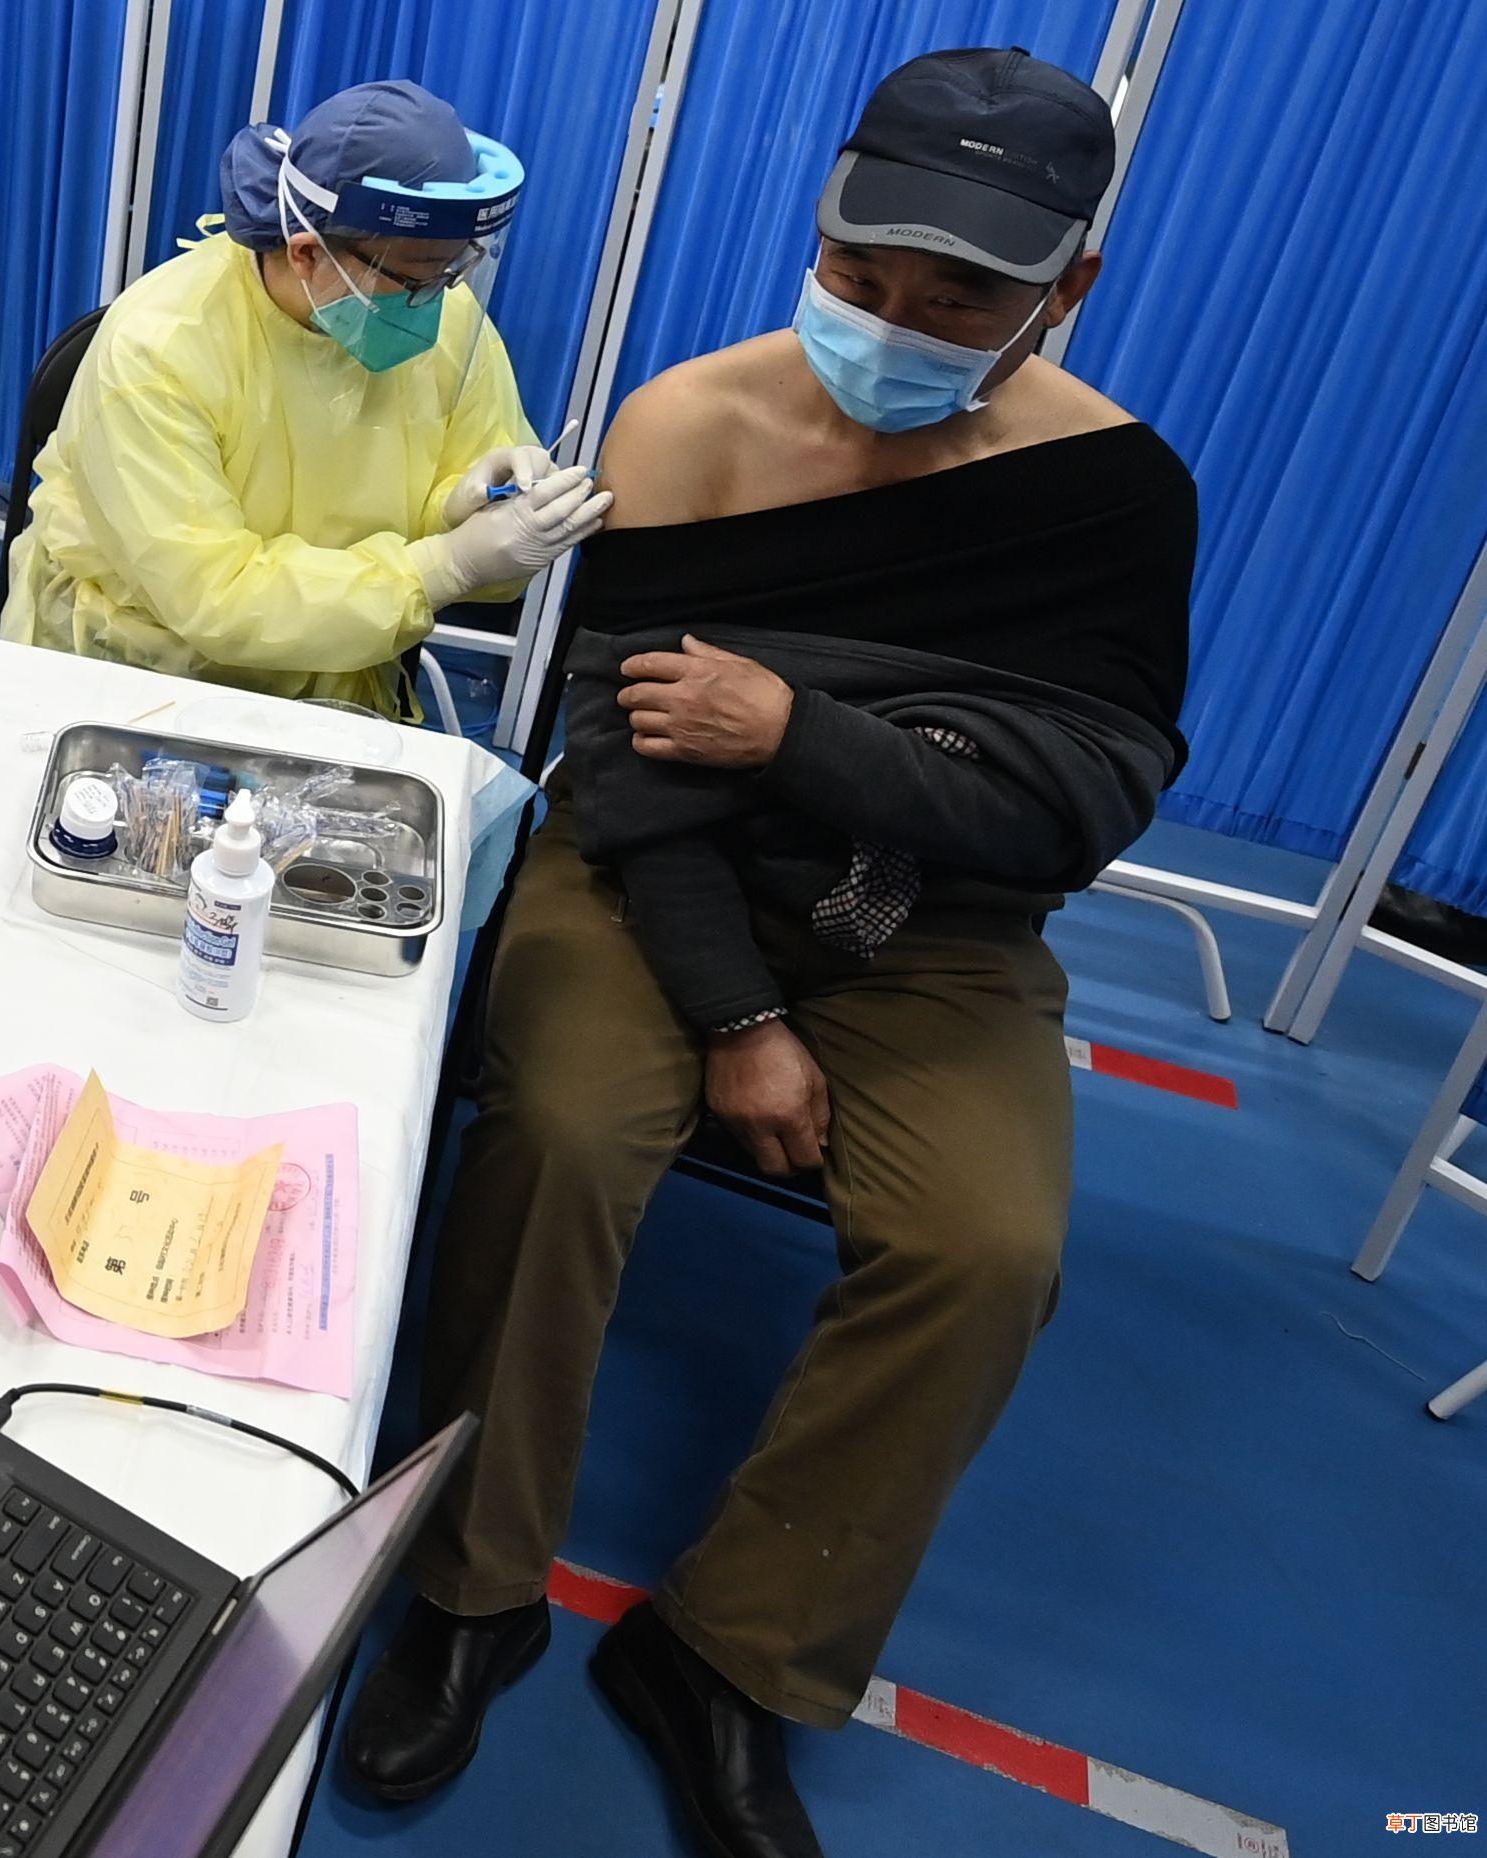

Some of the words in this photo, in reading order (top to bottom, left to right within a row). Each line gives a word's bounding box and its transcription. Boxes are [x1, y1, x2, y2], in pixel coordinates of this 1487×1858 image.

[959, 138, 1005, 156] MODERN
[886, 227, 956, 247] MODERN
[104, 1256, 126, 1276] 第
[129, 1189, 150, 1204] 号
[12, 1572, 25, 1585] Z
[53, 1580, 64, 1591] A
[34, 1606, 47, 1618] S
[70, 1621, 83, 1636] W
[15, 1631, 28, 1644] D
[52, 1646, 65, 1659] E
[33, 1674, 46, 1687] R
[14, 1703, 26, 1715] T
